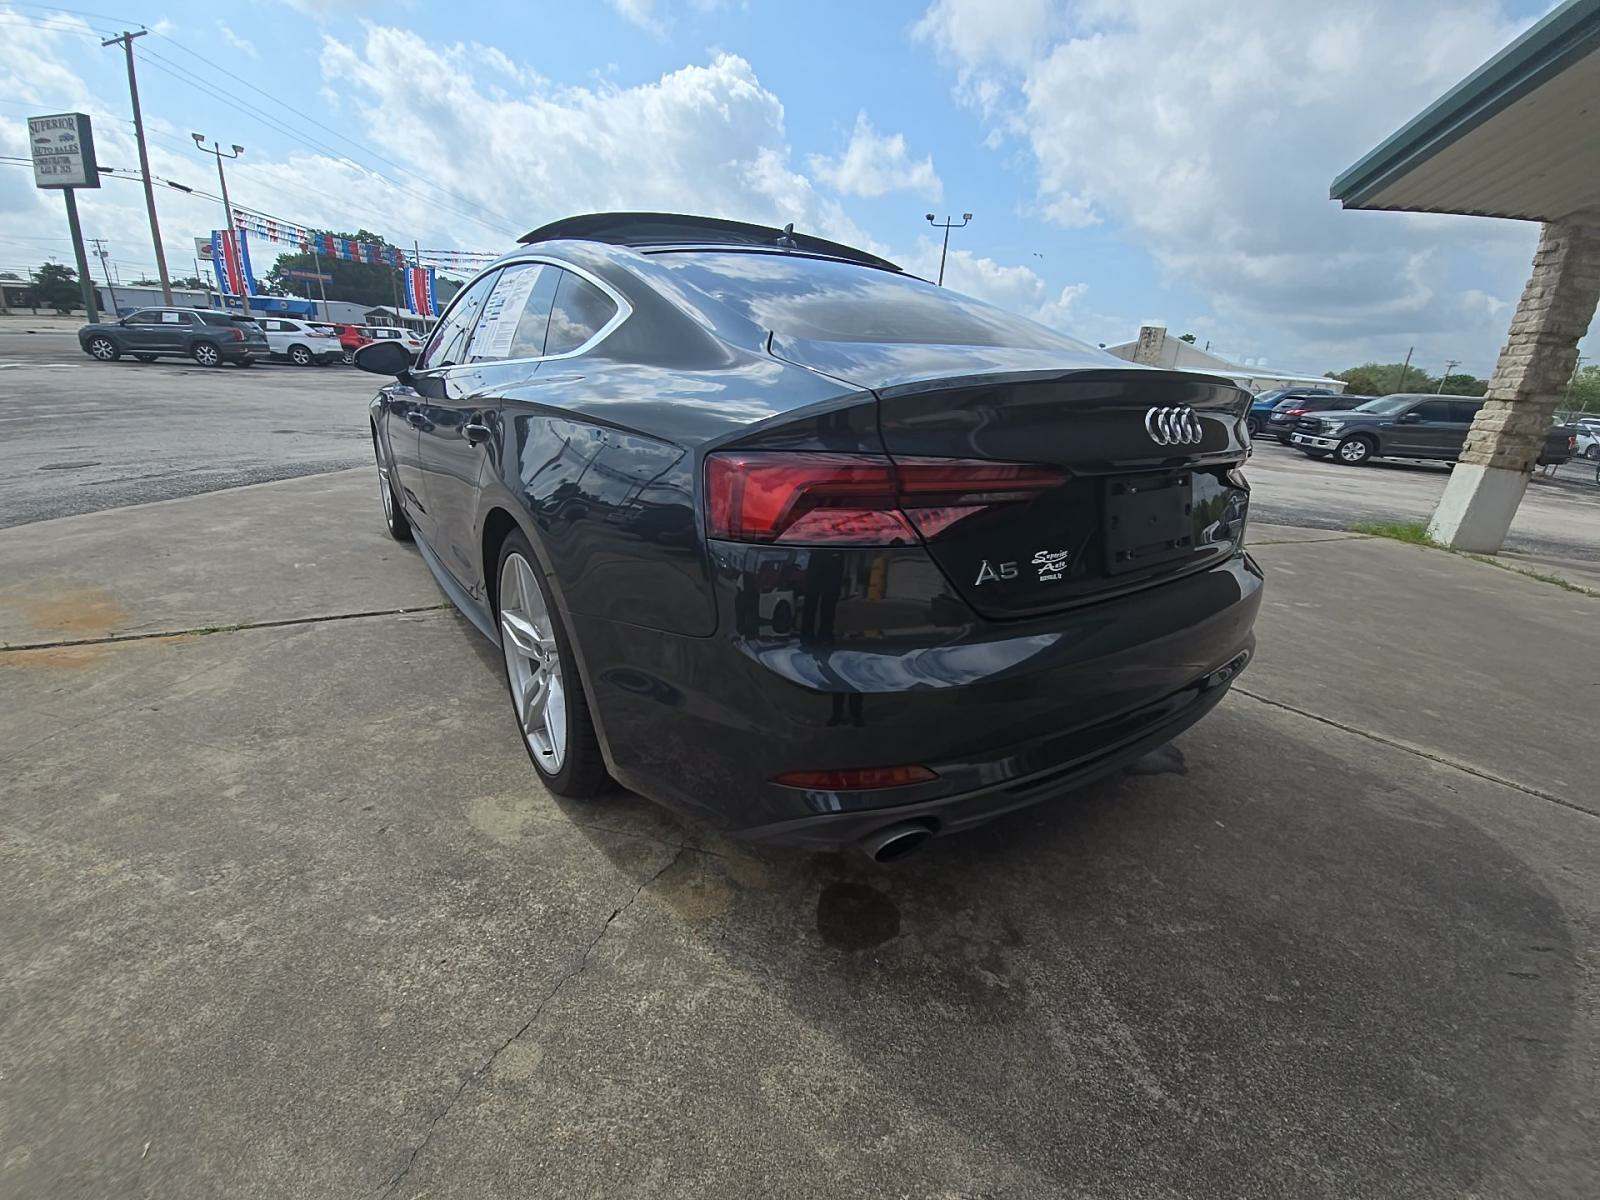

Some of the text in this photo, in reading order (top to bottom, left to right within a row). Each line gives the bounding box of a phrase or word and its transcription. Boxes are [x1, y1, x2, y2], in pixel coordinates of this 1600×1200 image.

[29, 118, 76, 135] SUPERIOR
[34, 143, 79, 155] AUTO SALES
[1031, 550, 1068, 564] Superior
[975, 560, 1018, 585] A5
[1038, 561, 1067, 575] Auto
